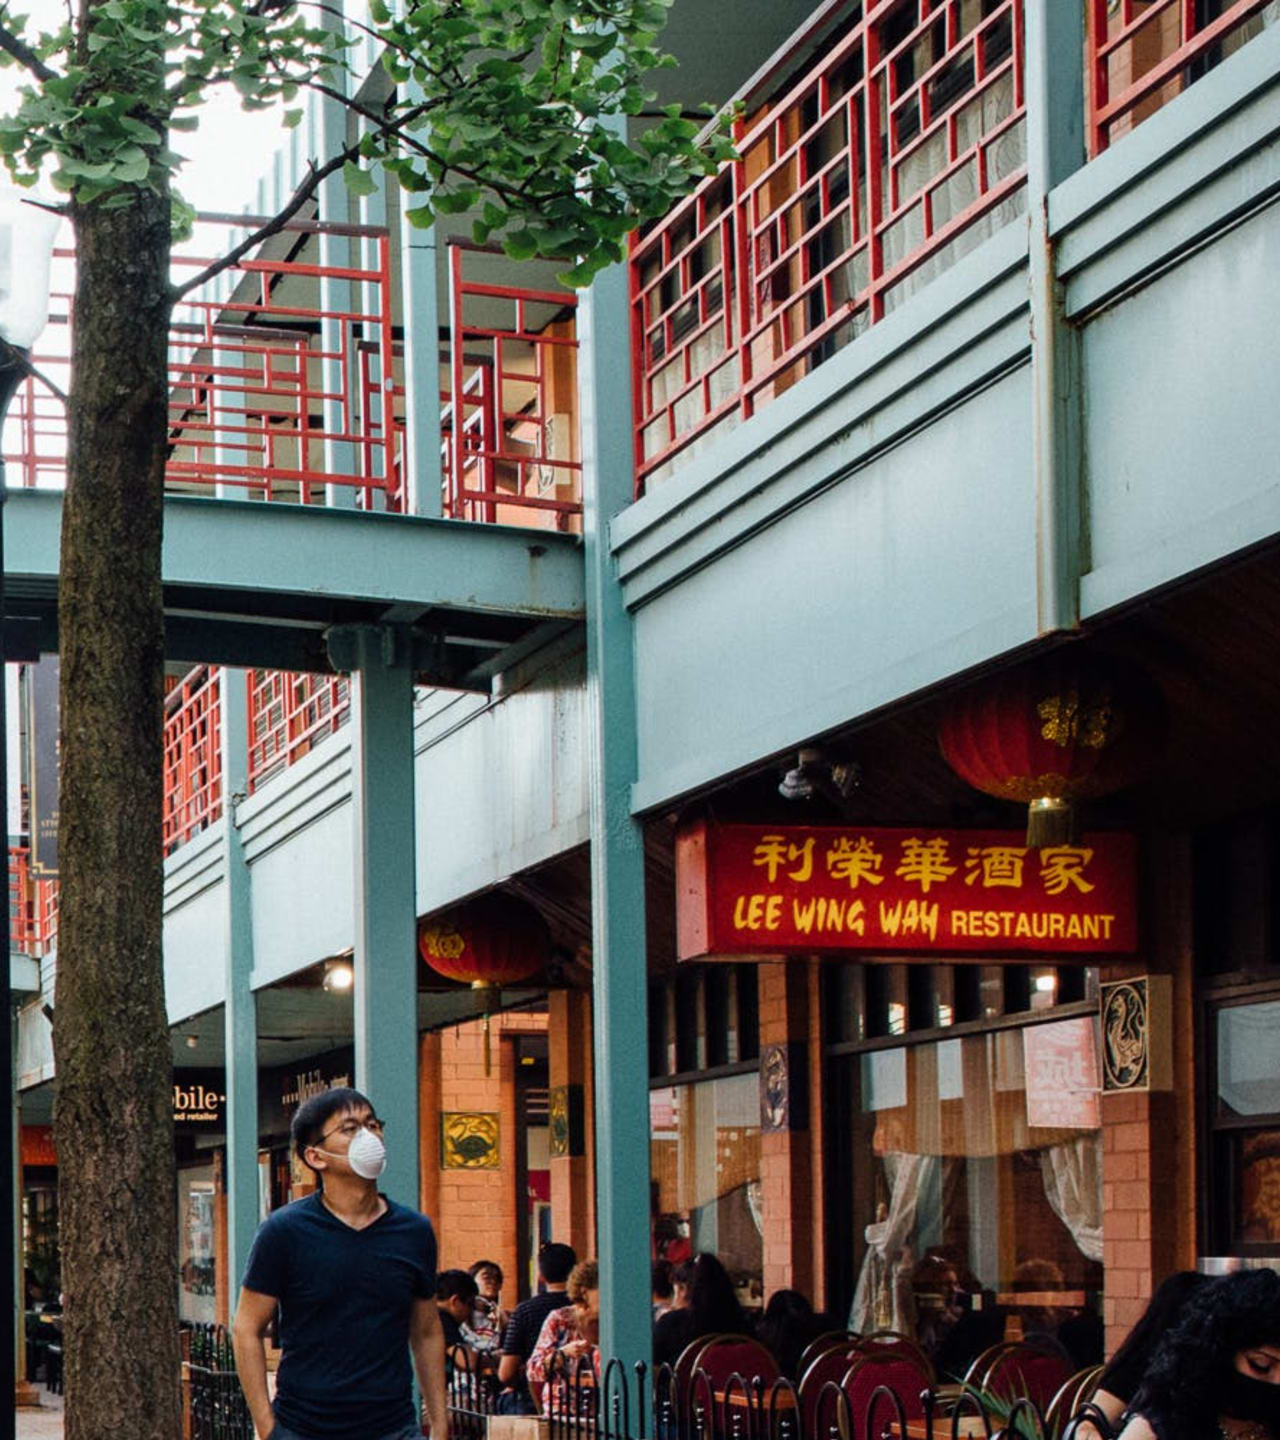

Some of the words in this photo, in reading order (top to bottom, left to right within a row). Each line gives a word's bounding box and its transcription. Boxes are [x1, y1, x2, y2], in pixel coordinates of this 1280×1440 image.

[752, 835, 1097, 896] 利榮華酒家
[733, 893, 783, 932] LEE
[792, 897, 865, 937] WING
[877, 898, 940, 943] WAH
[950, 910, 1116, 942] RESTAURANT
[171, 1084, 219, 1111] bile
[186, 1112, 219, 1121] retailer
